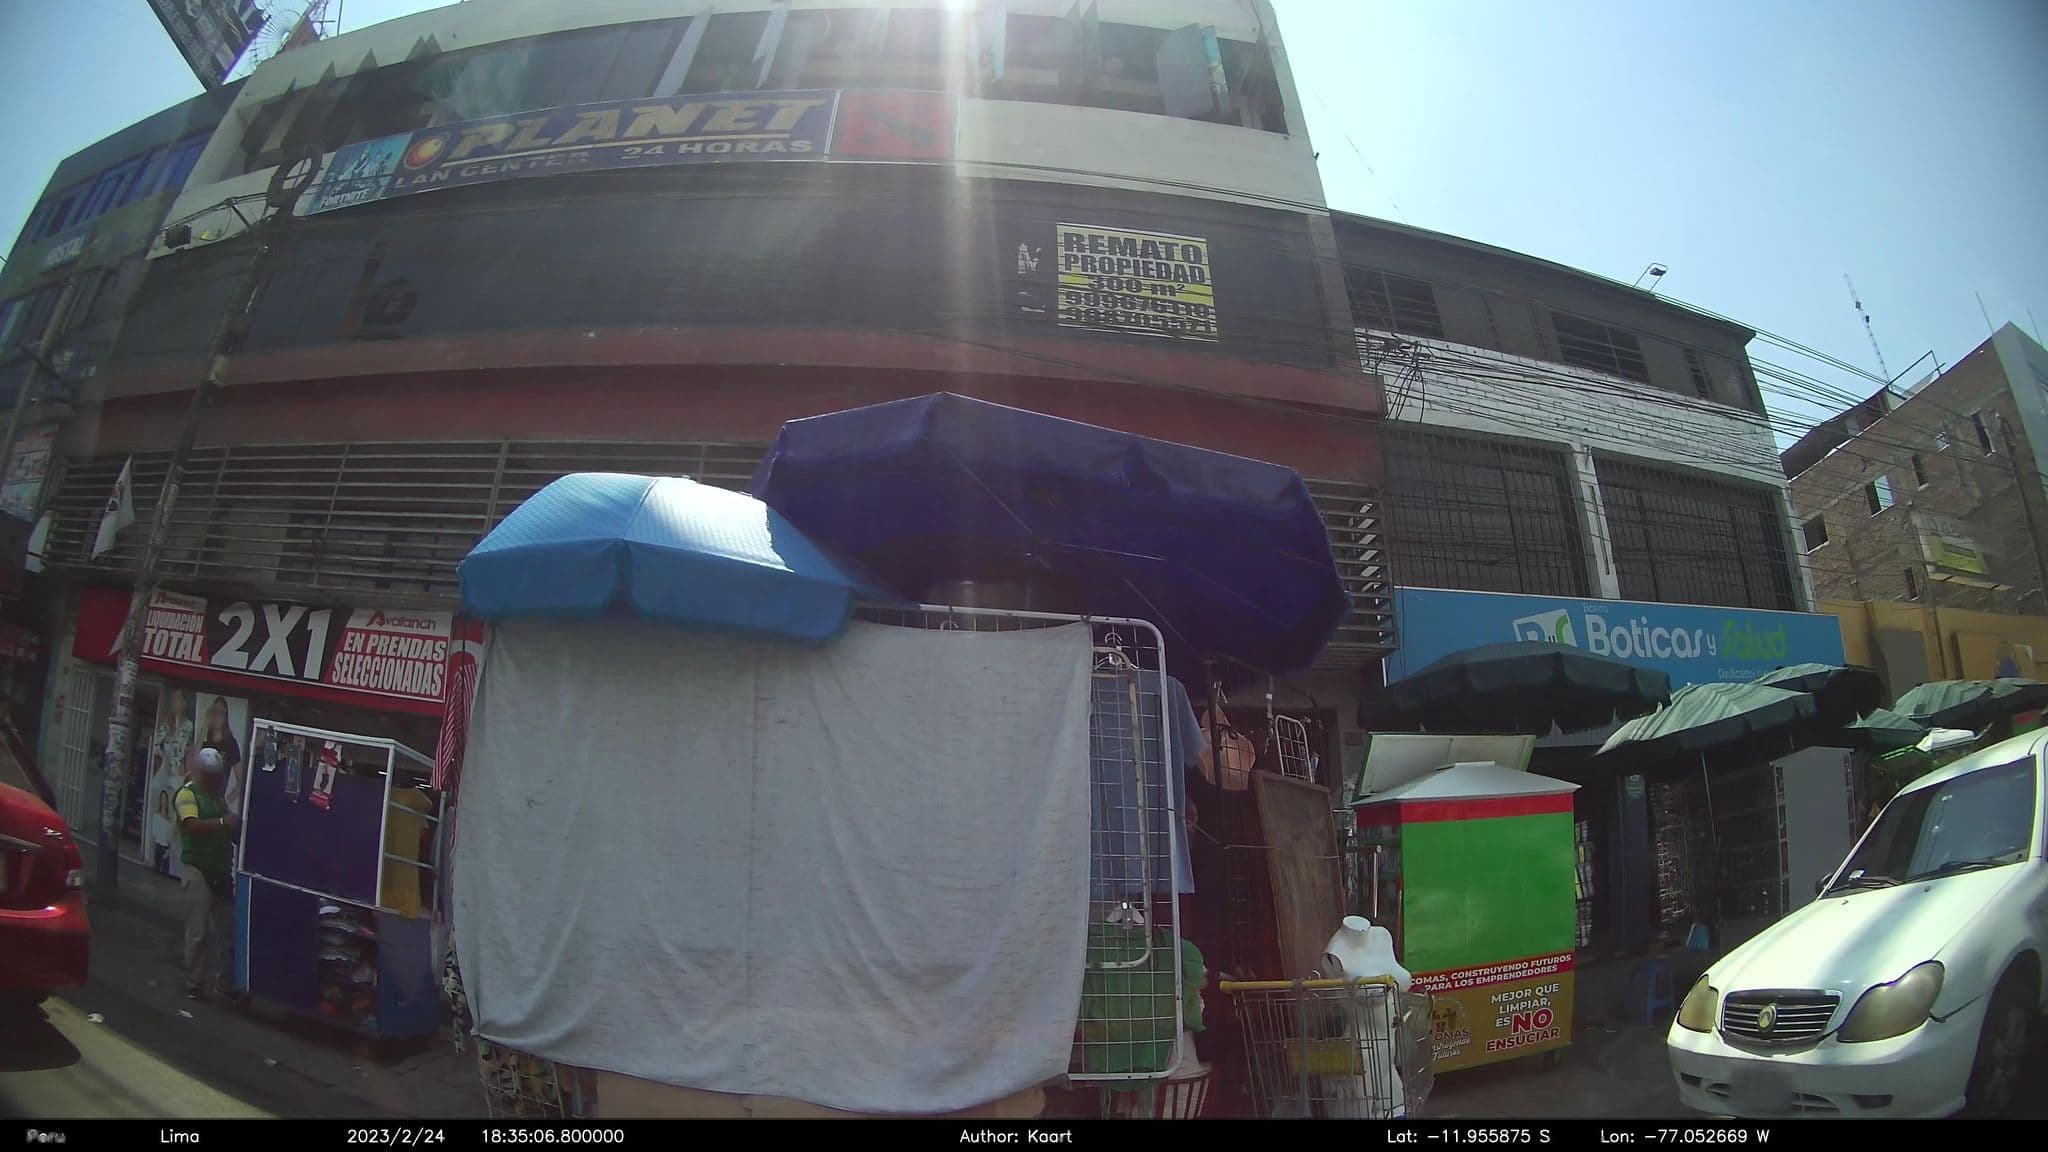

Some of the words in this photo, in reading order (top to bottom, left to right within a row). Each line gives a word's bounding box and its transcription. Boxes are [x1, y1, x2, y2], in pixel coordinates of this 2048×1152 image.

[453, 99, 833, 159] PLANET
[395, 168, 450, 188] LAN
[460, 151, 594, 178] CENTER
[621, 144, 664, 160] 24
[677, 139, 813, 156] HORAS
[319, 187, 371, 208] FORTNITE
[1063, 231, 1203, 265] REMATO
[1064, 252, 1206, 285] PROPIEDAD
[146, 609, 204, 634] LIQUIDACIÓN
[366, 610, 437, 632] Avalanch
[143, 627, 204, 663] TOTAL
[211, 601, 333, 680] 2X1
[343, 631, 366, 650] EN
[366, 632, 447, 663] PRENDAS
[1585, 614, 1702, 659] Boticas
[1706, 632, 1717, 656] y
[1722, 619, 1788, 660] Salud
[332, 653, 444, 698] SELECCIONADAS
[1425, 981, 1453, 992] PARA
[1455, 978, 1475, 988] LOS
[1476, 965, 1558, 985] EMPRENDEDORES
[1451, 961, 1529, 979] CONSTRUYENDO
[1530, 953, 1572, 968] FUTUROS
[1491, 988, 1532, 1004] MEJOR
[1535, 982, 1560, 997] QUE
[1499, 997, 1551, 1014] LIMPIAR,
[1433, 1027, 1471, 1042] OMAS
[1495, 1017, 1511, 1028] ES
[1512, 1007, 1554, 1035] NO
[1486, 1027, 1561, 1053] ENSUCIAR
